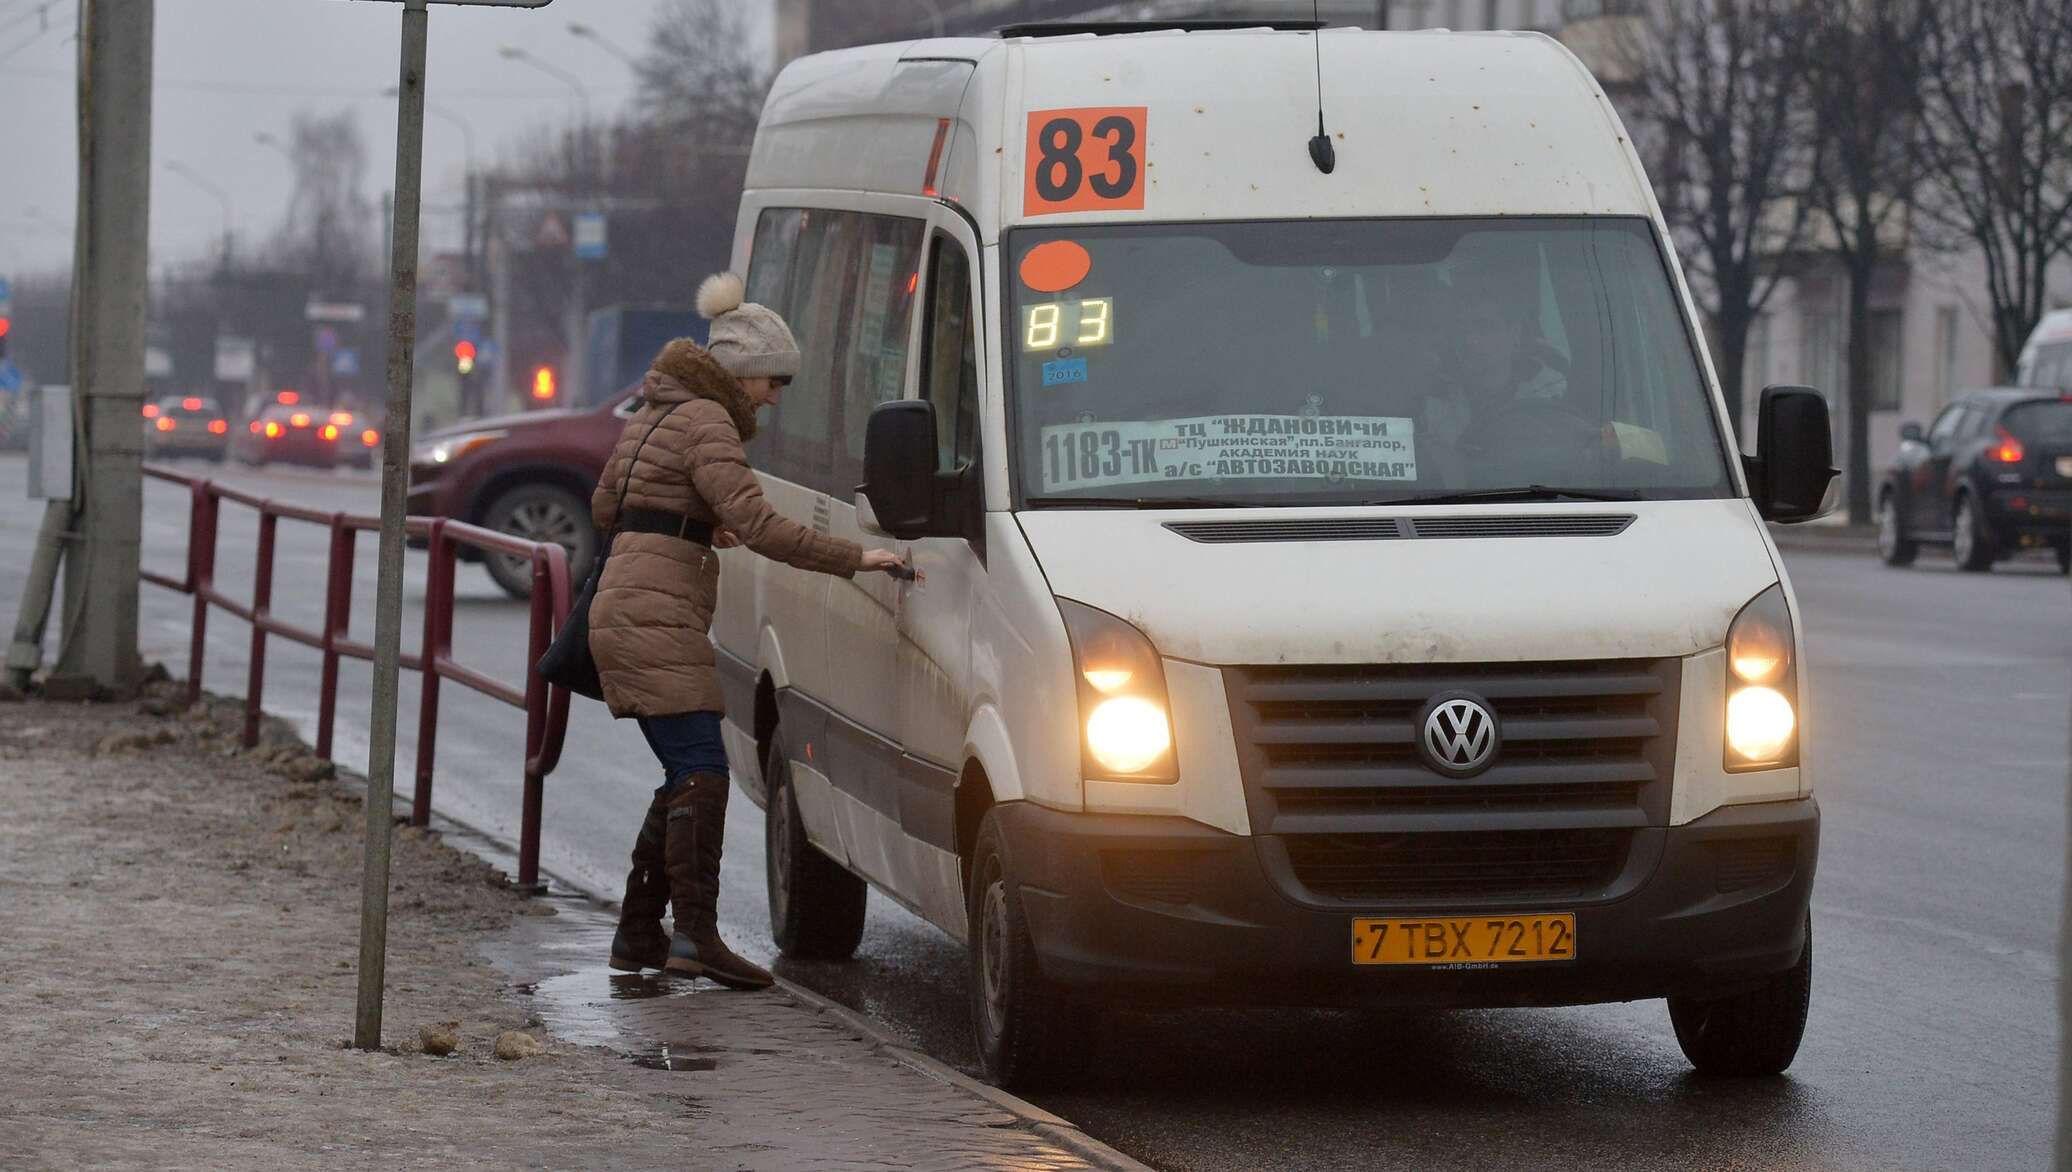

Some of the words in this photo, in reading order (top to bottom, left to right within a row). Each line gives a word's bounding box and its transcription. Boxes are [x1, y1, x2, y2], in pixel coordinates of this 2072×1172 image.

[1035, 115, 1137, 202] 83
[1027, 300, 1108, 347] 83
[1047, 369, 1081, 381] 2016
[1174, 423, 1207, 438] ТЦ
[1046, 430, 1159, 484] 1183-ТК
[1219, 449, 1310, 459] АКАДЕМИЯ
[1315, 450, 1359, 460] НАУК
[1164, 461, 1203, 478] а/с
[1369, 924, 1389, 959] 7
[1400, 922, 1472, 959] TBX
[1486, 919, 1568, 957] 7212
